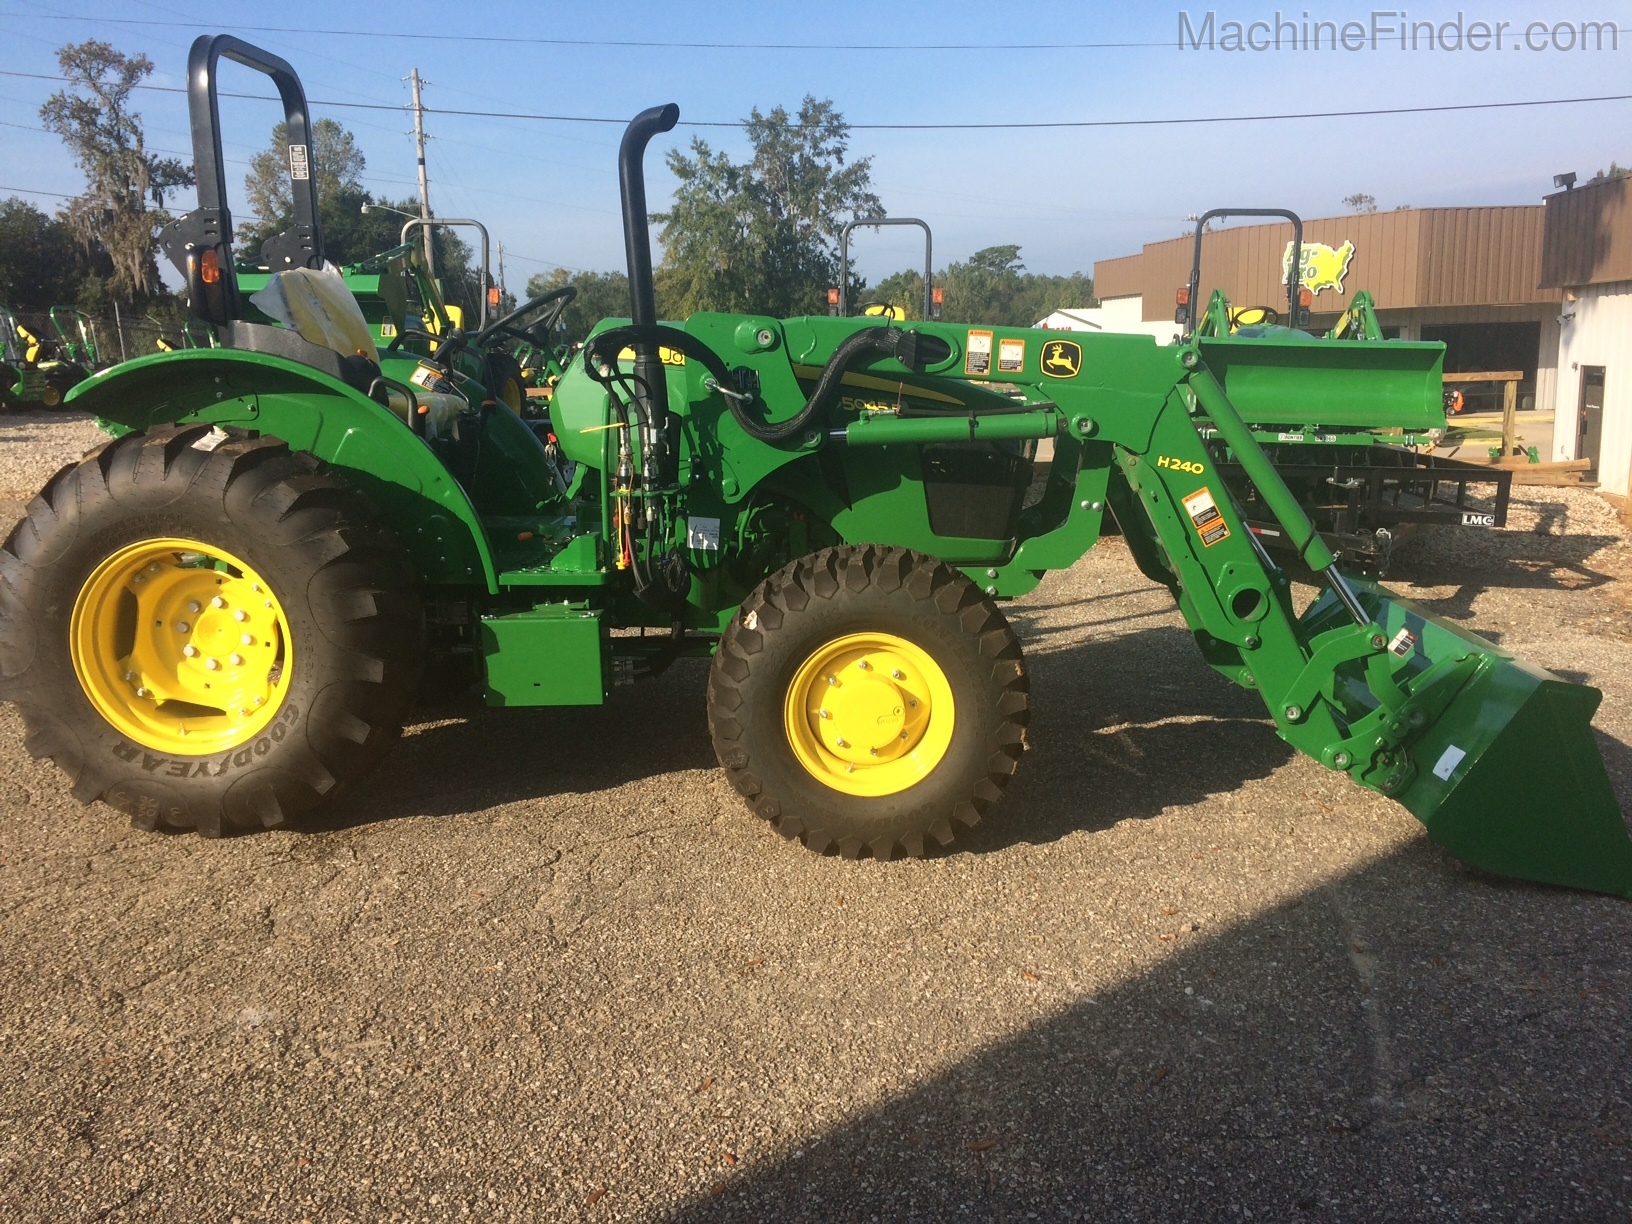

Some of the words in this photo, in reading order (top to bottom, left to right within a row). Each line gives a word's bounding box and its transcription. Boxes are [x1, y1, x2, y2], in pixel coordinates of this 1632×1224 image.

[1157, 456, 1204, 474] H240
[1463, 515, 1492, 526] LMC
[112, 703, 300, 779] GOODYEAR
